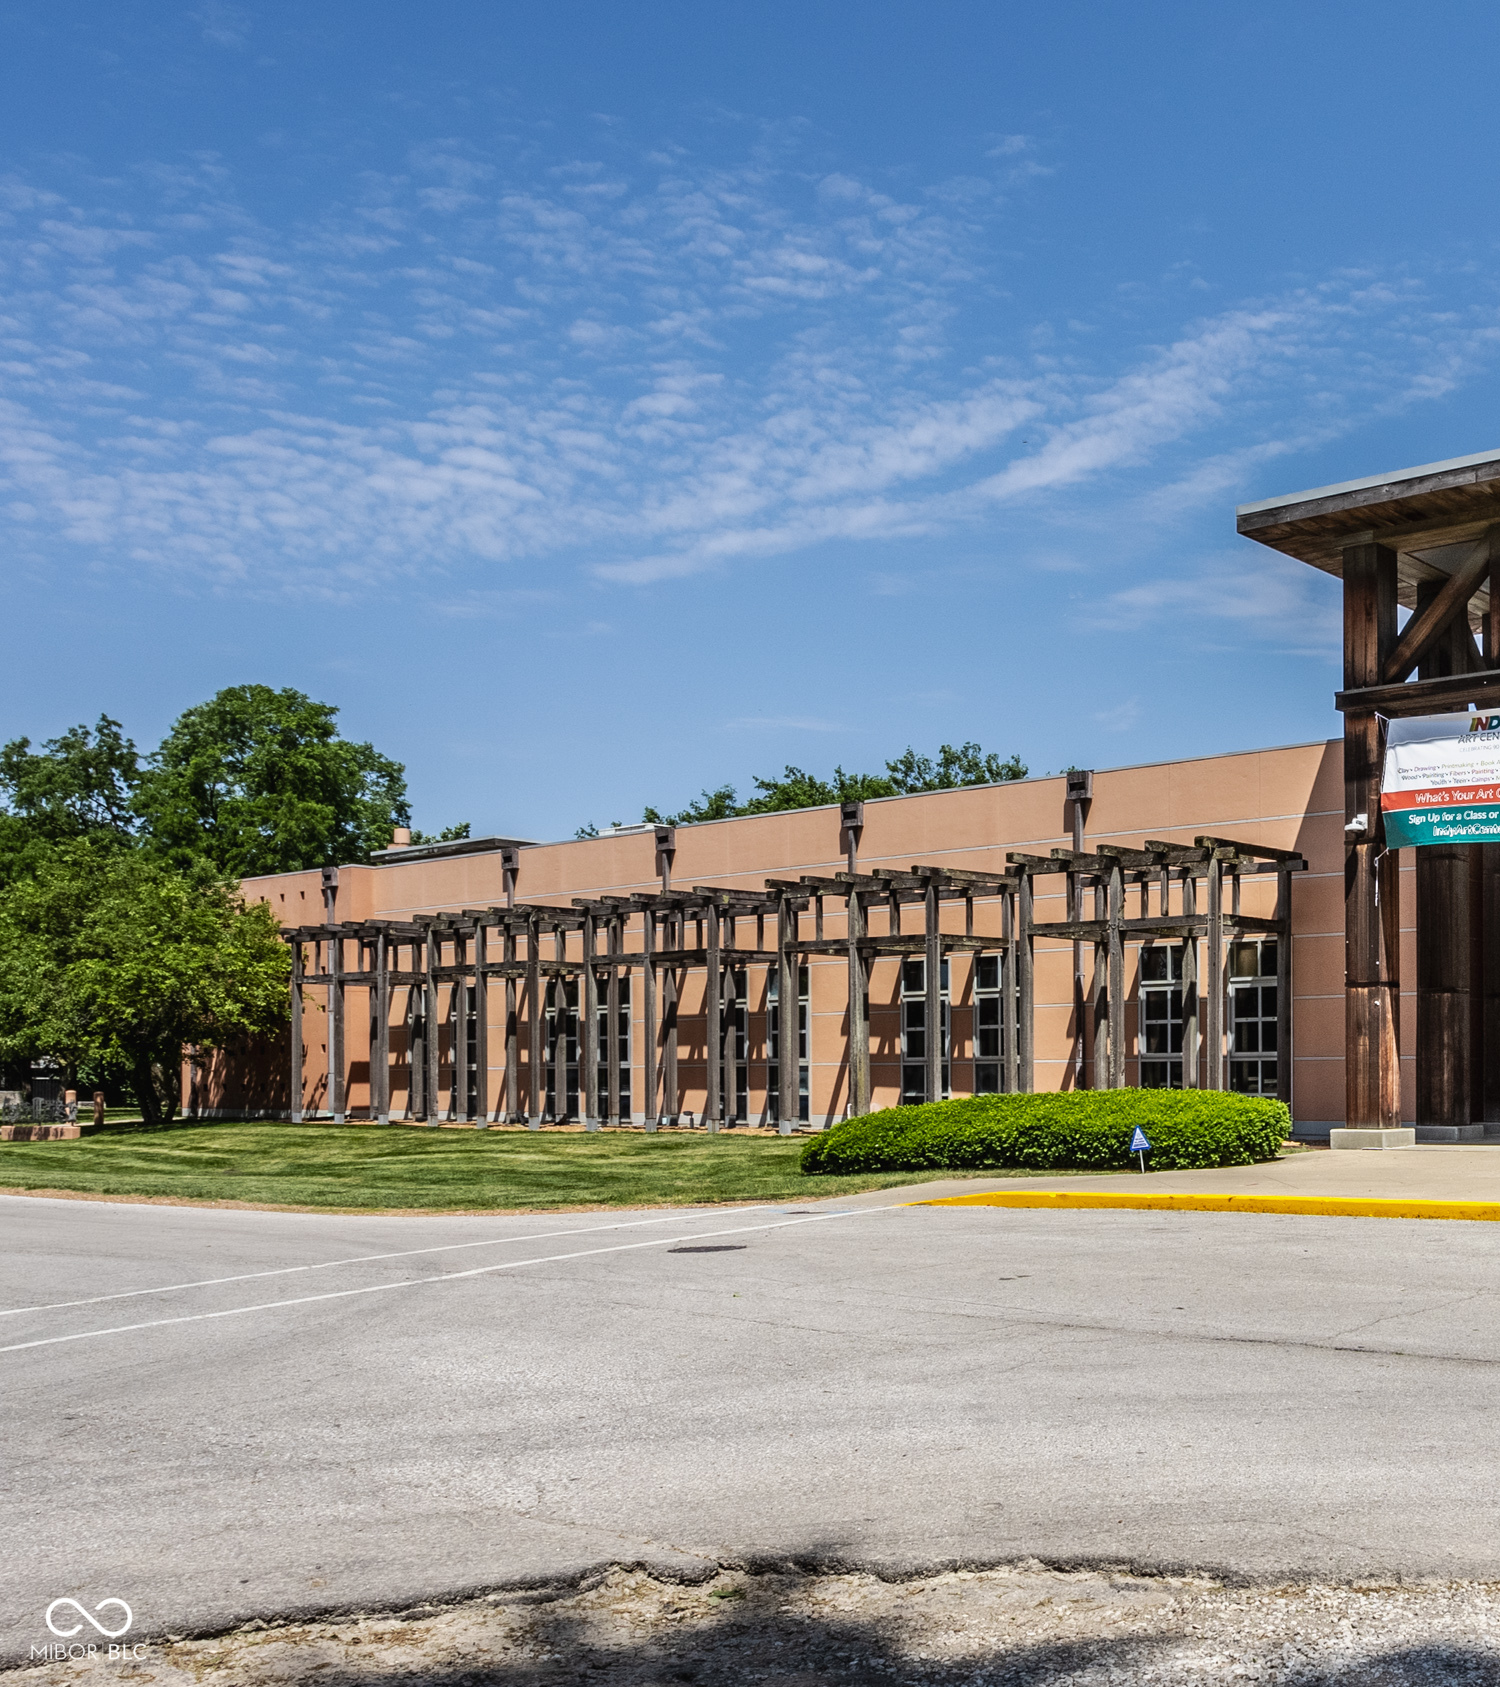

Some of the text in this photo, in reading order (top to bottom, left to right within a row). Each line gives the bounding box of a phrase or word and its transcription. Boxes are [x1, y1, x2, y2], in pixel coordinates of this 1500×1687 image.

[1458, 733, 1477, 743] ART
[1414, 765, 1436, 773] Drawing
[1415, 791, 1449, 804] What's
[1451, 790, 1474, 801] Your
[1476, 788, 1493, 799] Art
[1408, 814, 1425, 825] Sign
[1428, 813, 1440, 823] Up
[1442, 812, 1455, 821] for
[1464, 810, 1486, 820] Class
